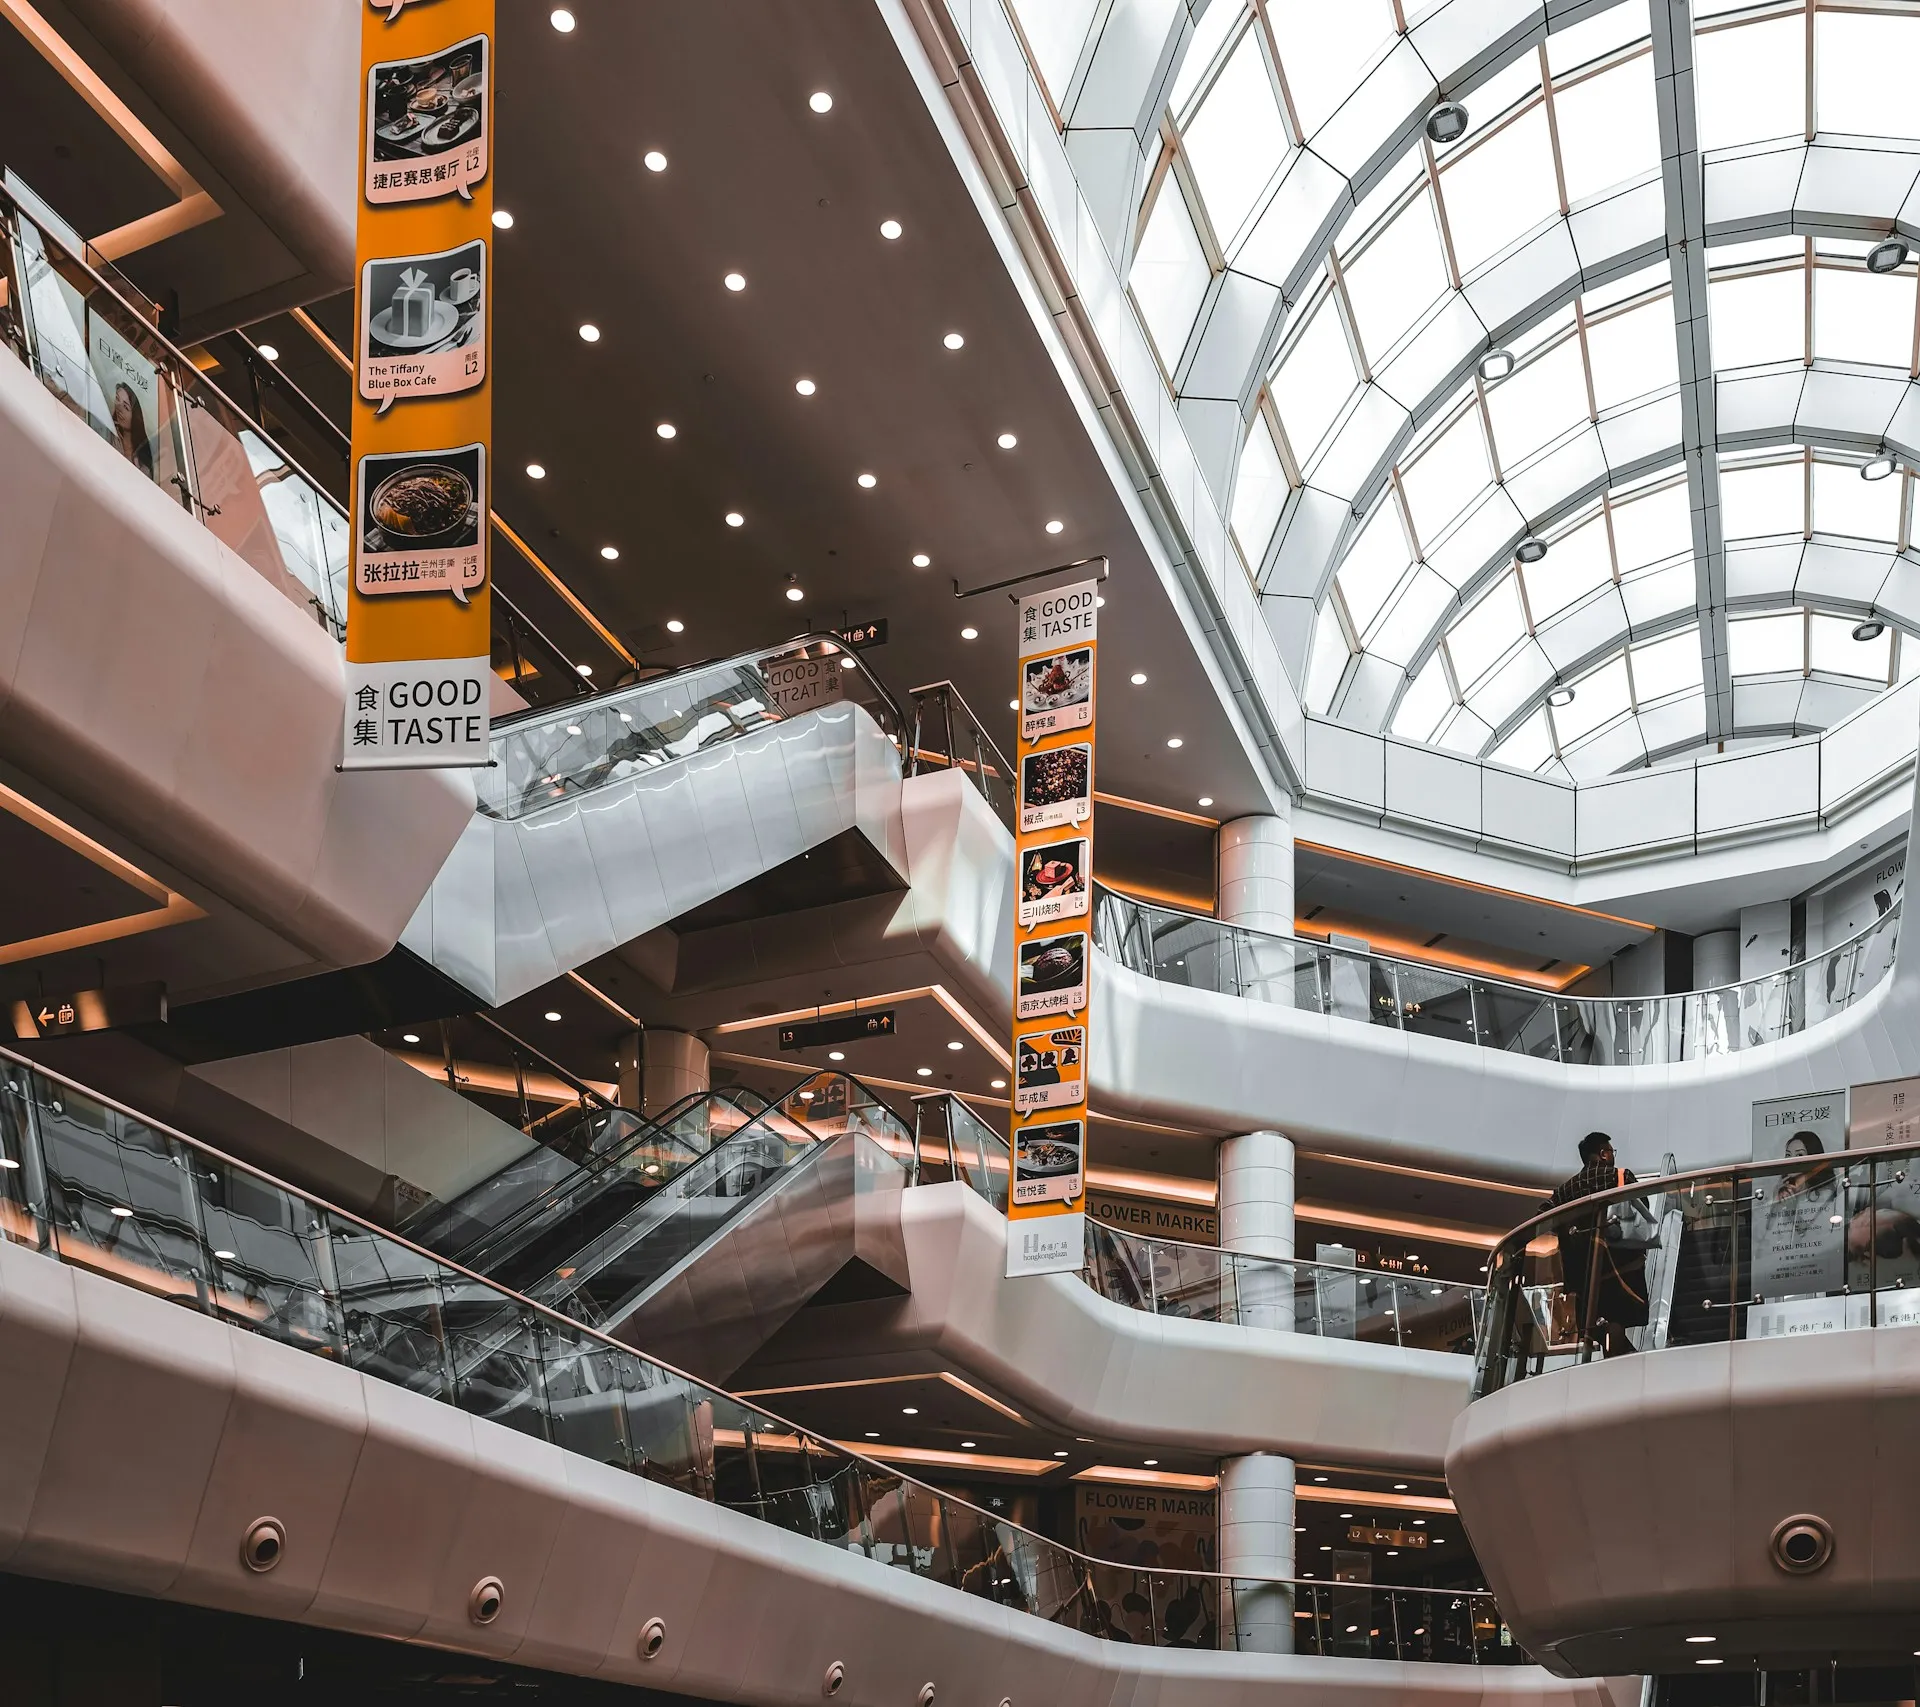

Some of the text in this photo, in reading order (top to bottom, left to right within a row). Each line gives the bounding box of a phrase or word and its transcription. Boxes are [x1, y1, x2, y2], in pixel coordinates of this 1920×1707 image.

[466, 157, 480, 171] L2
[373, 159, 460, 189] 捷尼赛思餐厅
[369, 363, 425, 376] The Tiffany
[465, 361, 478, 375] L2
[368, 375, 437, 389] Blue Box Cafe
[421, 558, 456, 569] 兰州手撕
[364, 560, 420, 583] 张拉拉
[420, 568, 446, 579] 牛肉面
[463, 565, 478, 578] L3
[1042, 592, 1093, 617] GOOD
[1042, 612, 1093, 638] TASTE
[388, 678, 482, 709] GOOD
[388, 715, 482, 746] TASTE
[1025, 715, 1056, 732] 醉辉皇
[1024, 812, 1044, 826] 椒点
[1022, 903, 1061, 919] 三川烧肉
[1020, 994, 1069, 1012] 南京大牌档
[782, 1031, 794, 1042] L3
[1018, 1091, 1049, 1104] 平成屋
[1016, 1184, 1047, 1198] 恒悦荟
[1040, 1241, 1068, 1251] 香港广场
[1772, 1240, 1823, 1252] PEARL DELUXE
[1023, 1251, 1068, 1261] hongkongplaza
[1357, 1254, 1366, 1263] L3
[1789, 1321, 1833, 1333] 香港广场
[1085, 1491, 1157, 1512] FLOWER
[1352, 1530, 1361, 1538] L2
